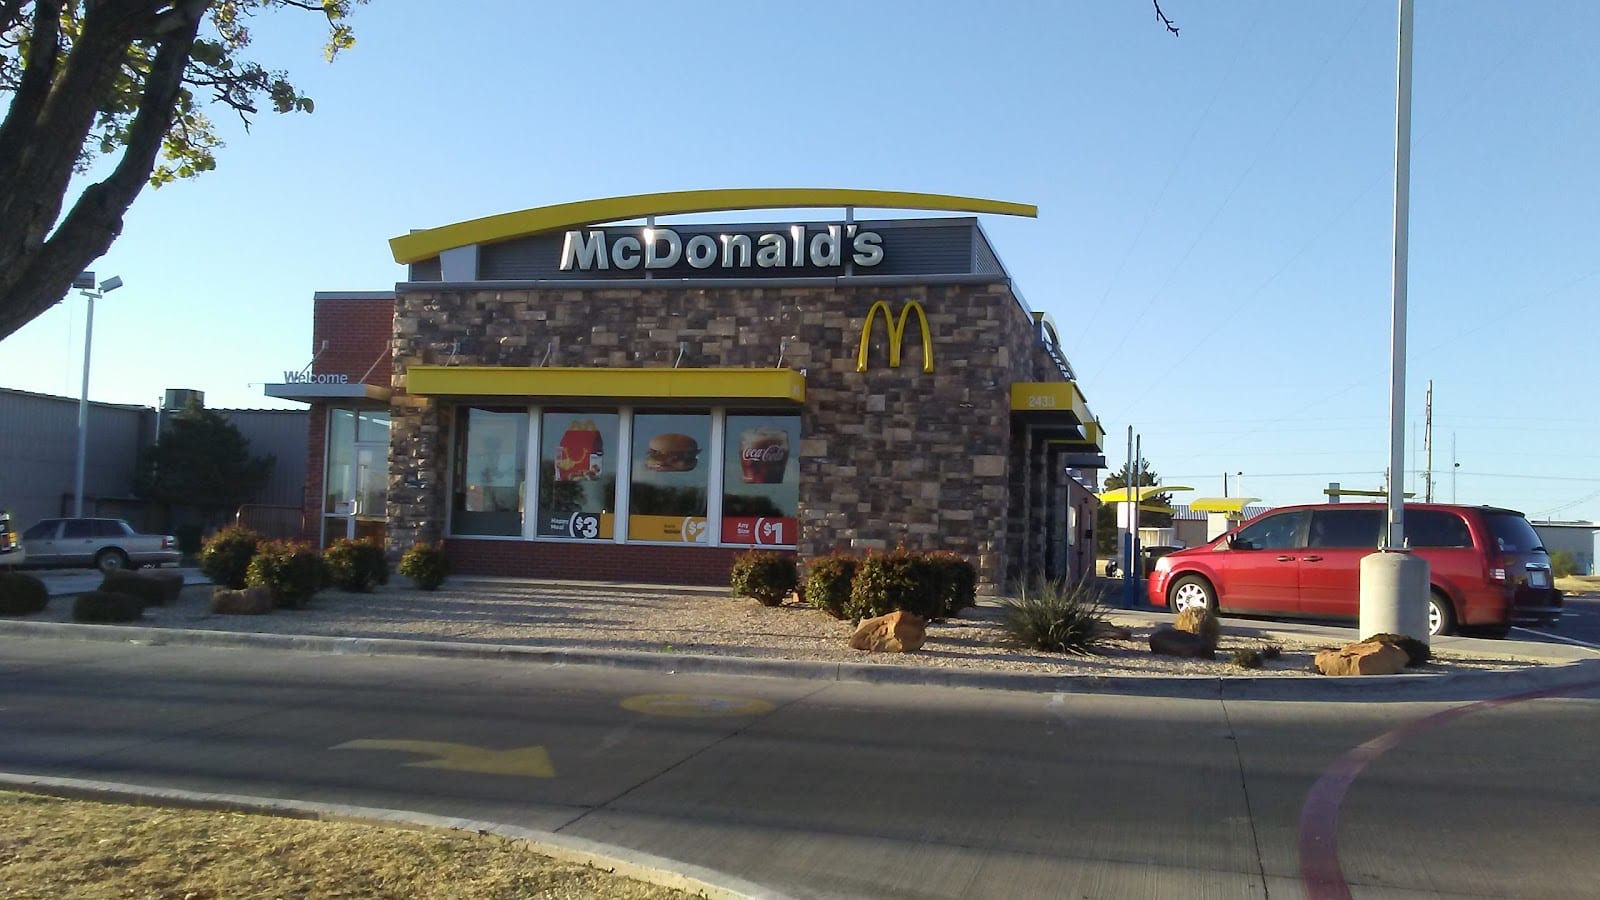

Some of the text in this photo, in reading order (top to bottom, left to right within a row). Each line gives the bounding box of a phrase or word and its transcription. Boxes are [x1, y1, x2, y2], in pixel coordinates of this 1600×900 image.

[559, 224, 885, 271] McDonald's
[284, 371, 348, 384] Welcome
[763, 522, 783, 544] $1
